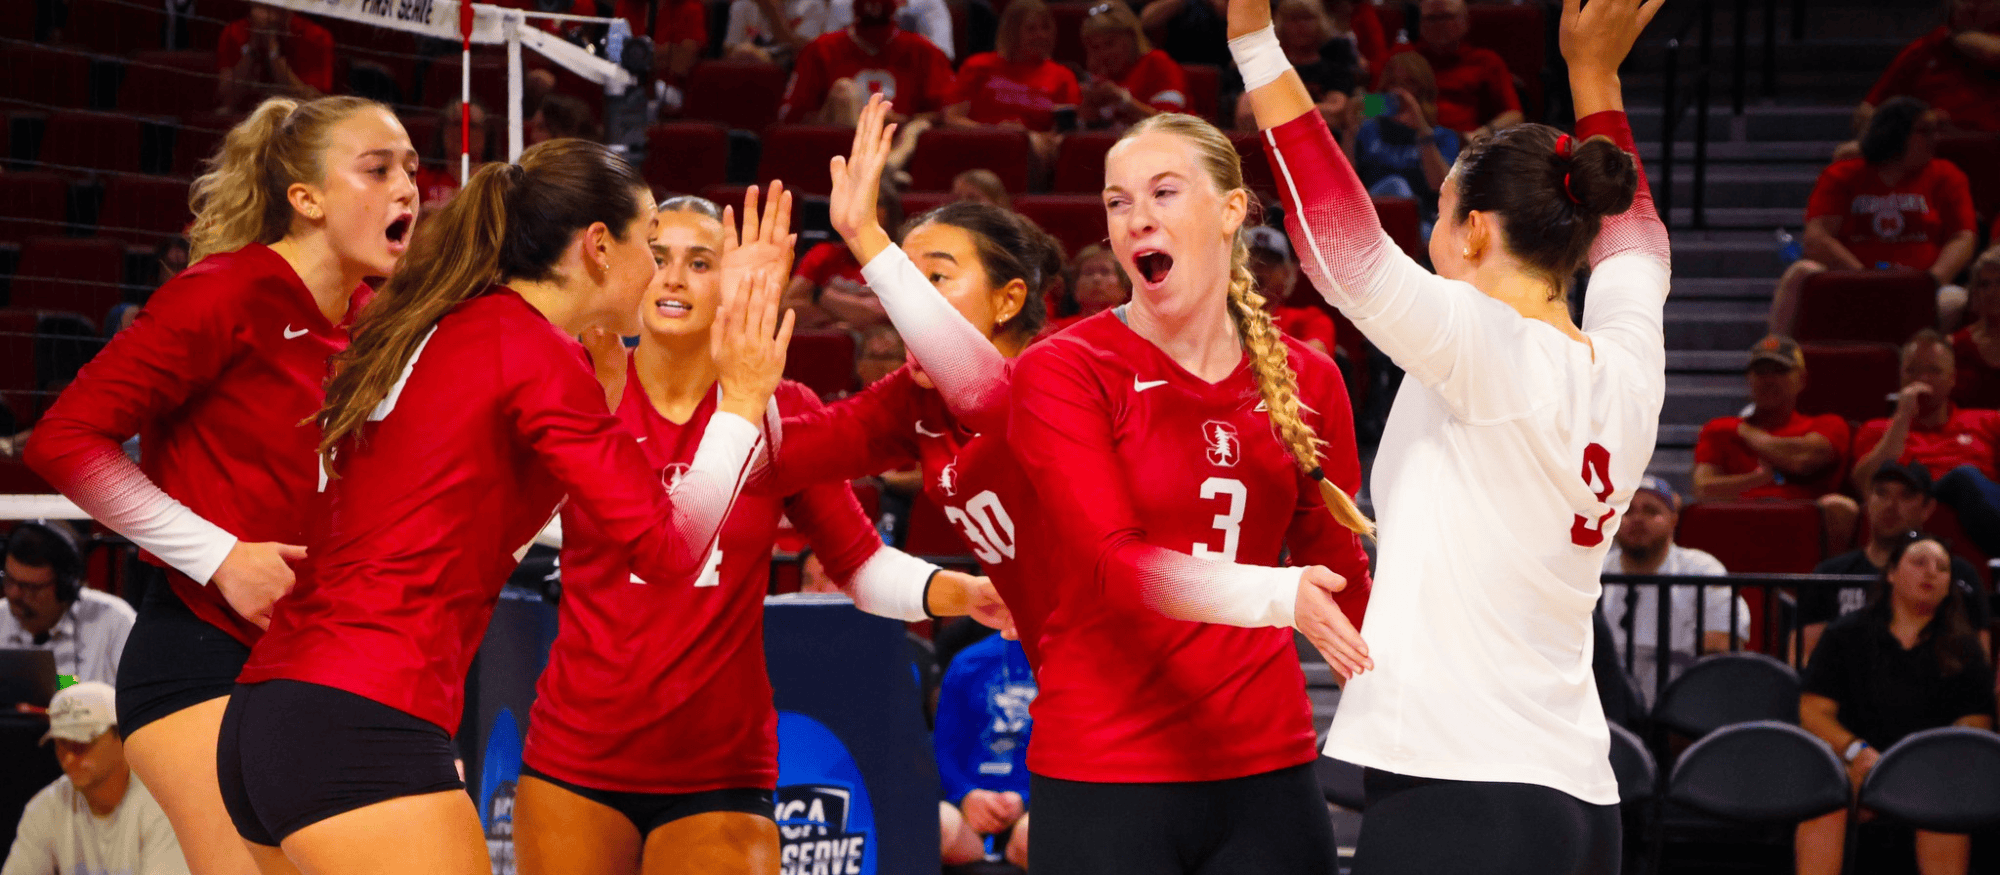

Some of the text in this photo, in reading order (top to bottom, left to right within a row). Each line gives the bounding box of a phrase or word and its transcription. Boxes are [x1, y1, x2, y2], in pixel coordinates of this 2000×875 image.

[397, 0, 433, 25] SERVE
[944, 490, 1016, 565] 30
[1192, 476, 1247, 562] 3
[1568, 442, 1615, 548] 9
[781, 837, 864, 875] SERVE
